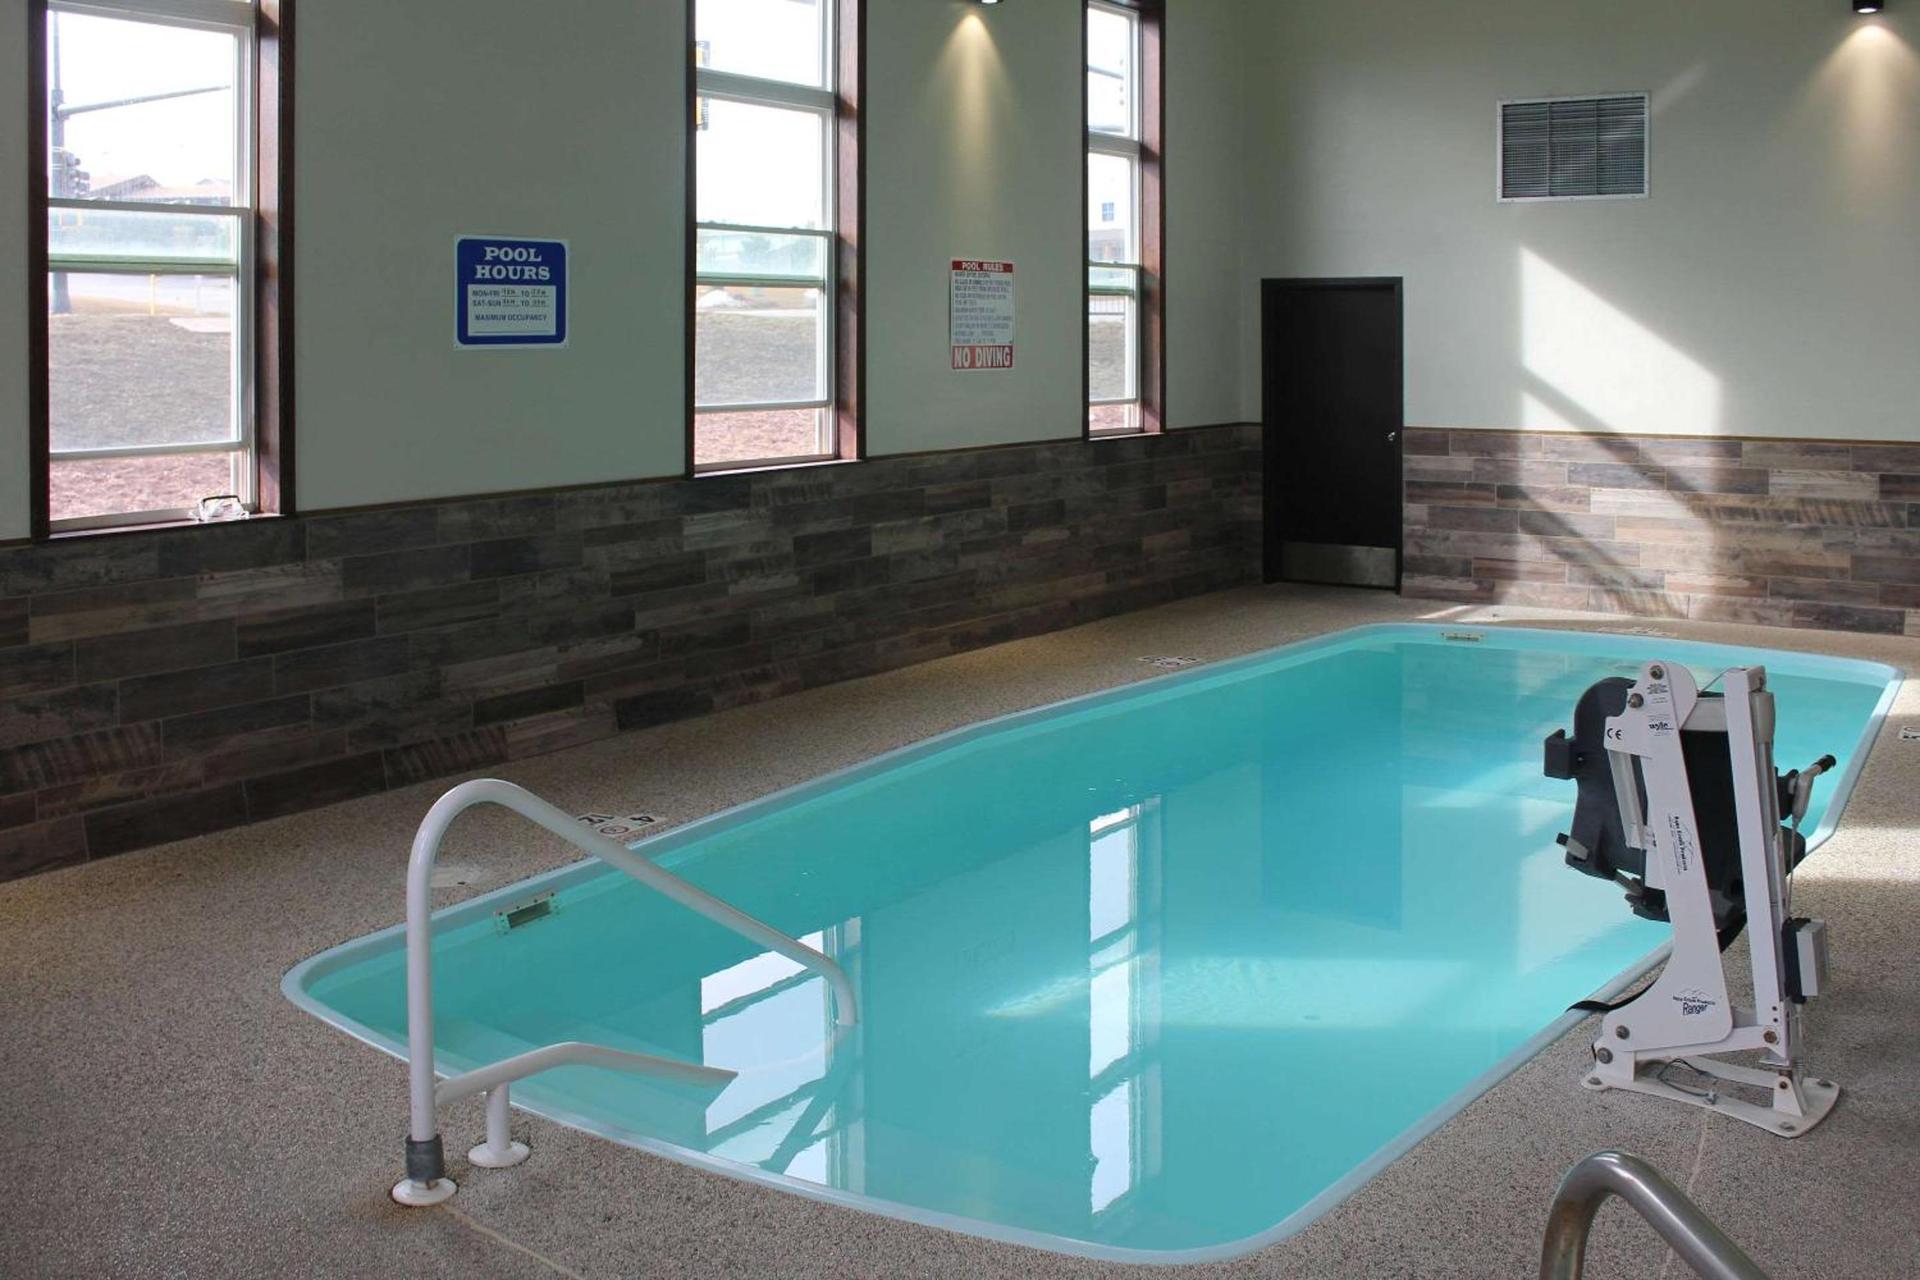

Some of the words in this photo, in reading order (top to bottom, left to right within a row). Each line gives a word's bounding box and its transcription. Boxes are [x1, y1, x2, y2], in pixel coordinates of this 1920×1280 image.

[484, 247, 542, 262] POOL
[475, 265, 551, 281] HOURS
[962, 261, 979, 271] POOL
[521, 290, 530, 298] TO
[507, 313, 547, 321] OCCUPANCY
[954, 346, 971, 367] NO
[975, 346, 1011, 367] DIVING
[1682, 1002, 1708, 1016] Ranger
